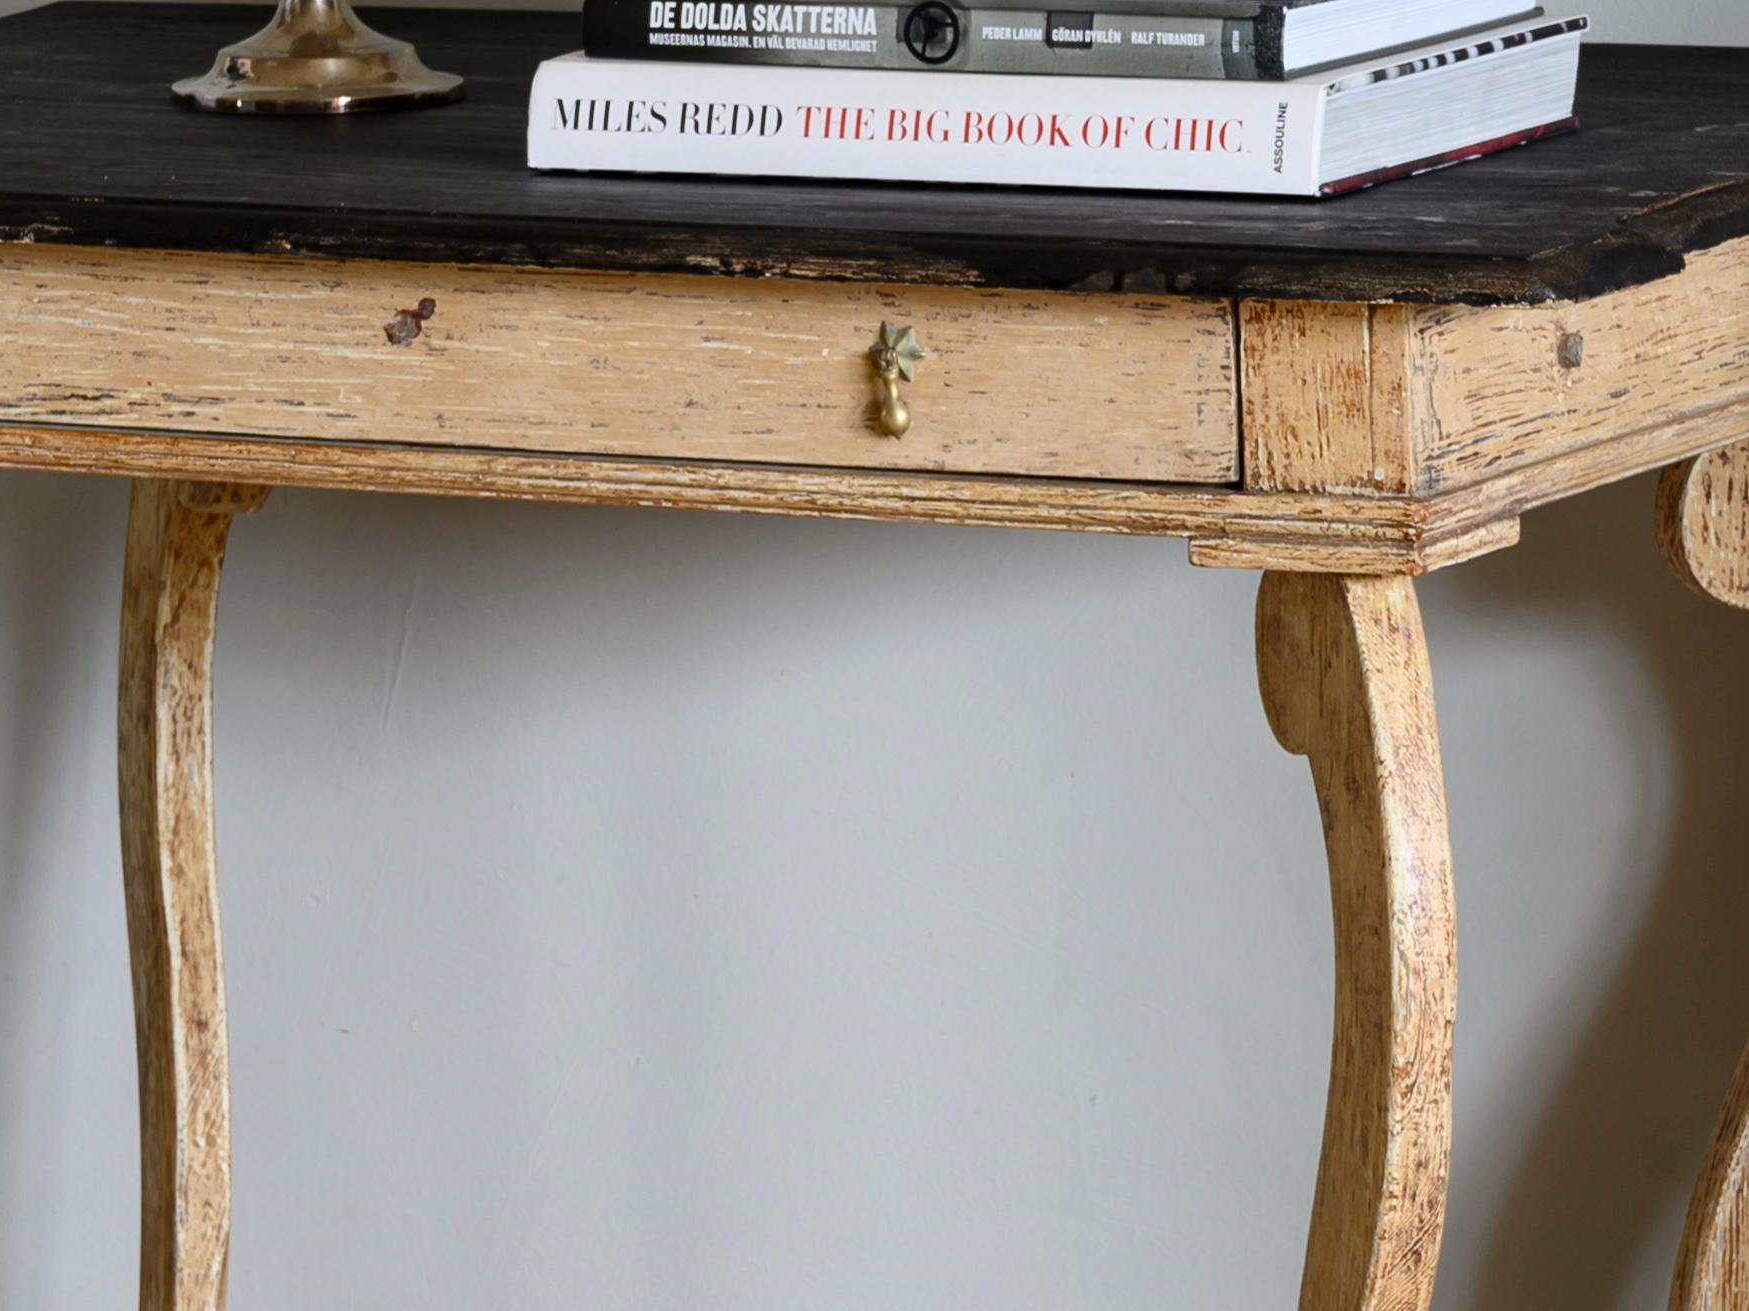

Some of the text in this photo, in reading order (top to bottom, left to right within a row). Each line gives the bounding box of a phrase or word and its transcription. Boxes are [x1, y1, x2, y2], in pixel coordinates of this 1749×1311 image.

[649, 0, 878, 36] DE DOLDA SKATTERNA
[982, 26, 1012, 41] PEDER
[1012, 28, 1043, 42] LAMM
[1051, 26, 1084, 43] GÖRAN
[1130, 30, 1155, 45] RALF
[649, 32, 706, 47] MUSEERNAS
[707, 34, 751, 49] MAGASIN.
[753, 36, 767, 49] EN
[768, 34, 784, 50] VÄL
[826, 38, 878, 53] HEMLIGHET
[551, 97, 1244, 153] MILES REDD THE BIG BOOK OF CHIC
[1272, 101, 1289, 174] ASSOULINE
